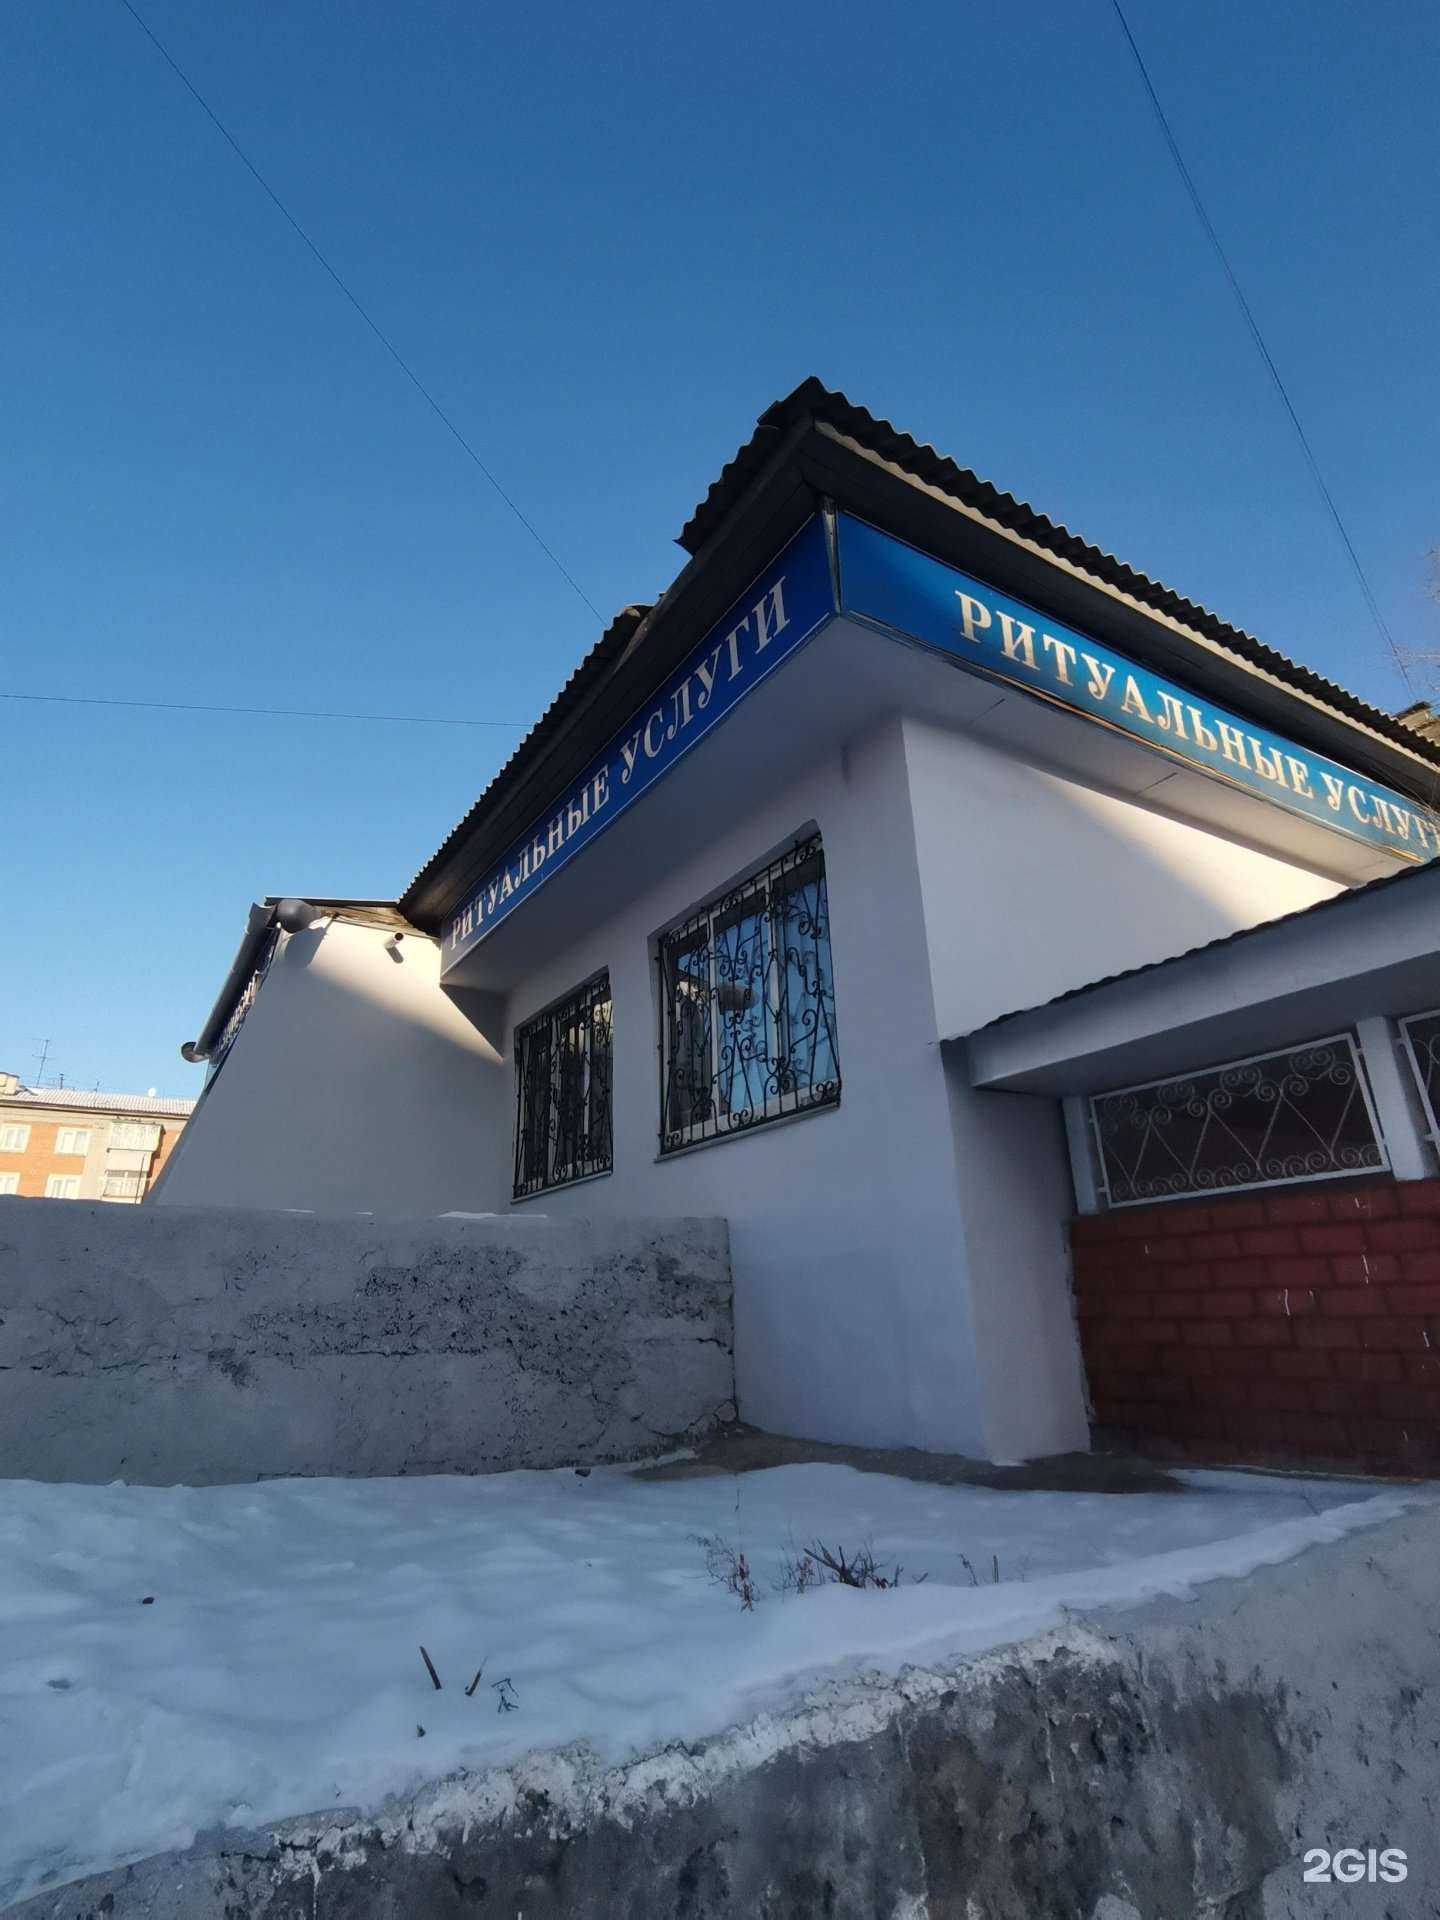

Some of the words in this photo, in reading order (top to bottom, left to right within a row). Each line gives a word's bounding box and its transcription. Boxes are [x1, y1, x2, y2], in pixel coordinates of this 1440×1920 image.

[451, 766, 609, 950] РИТУАЛЬНЫЕ
[620, 575, 790, 784] УСЛУГИ
[954, 590, 1314, 800] РИТУАЛЬНЫЕ
